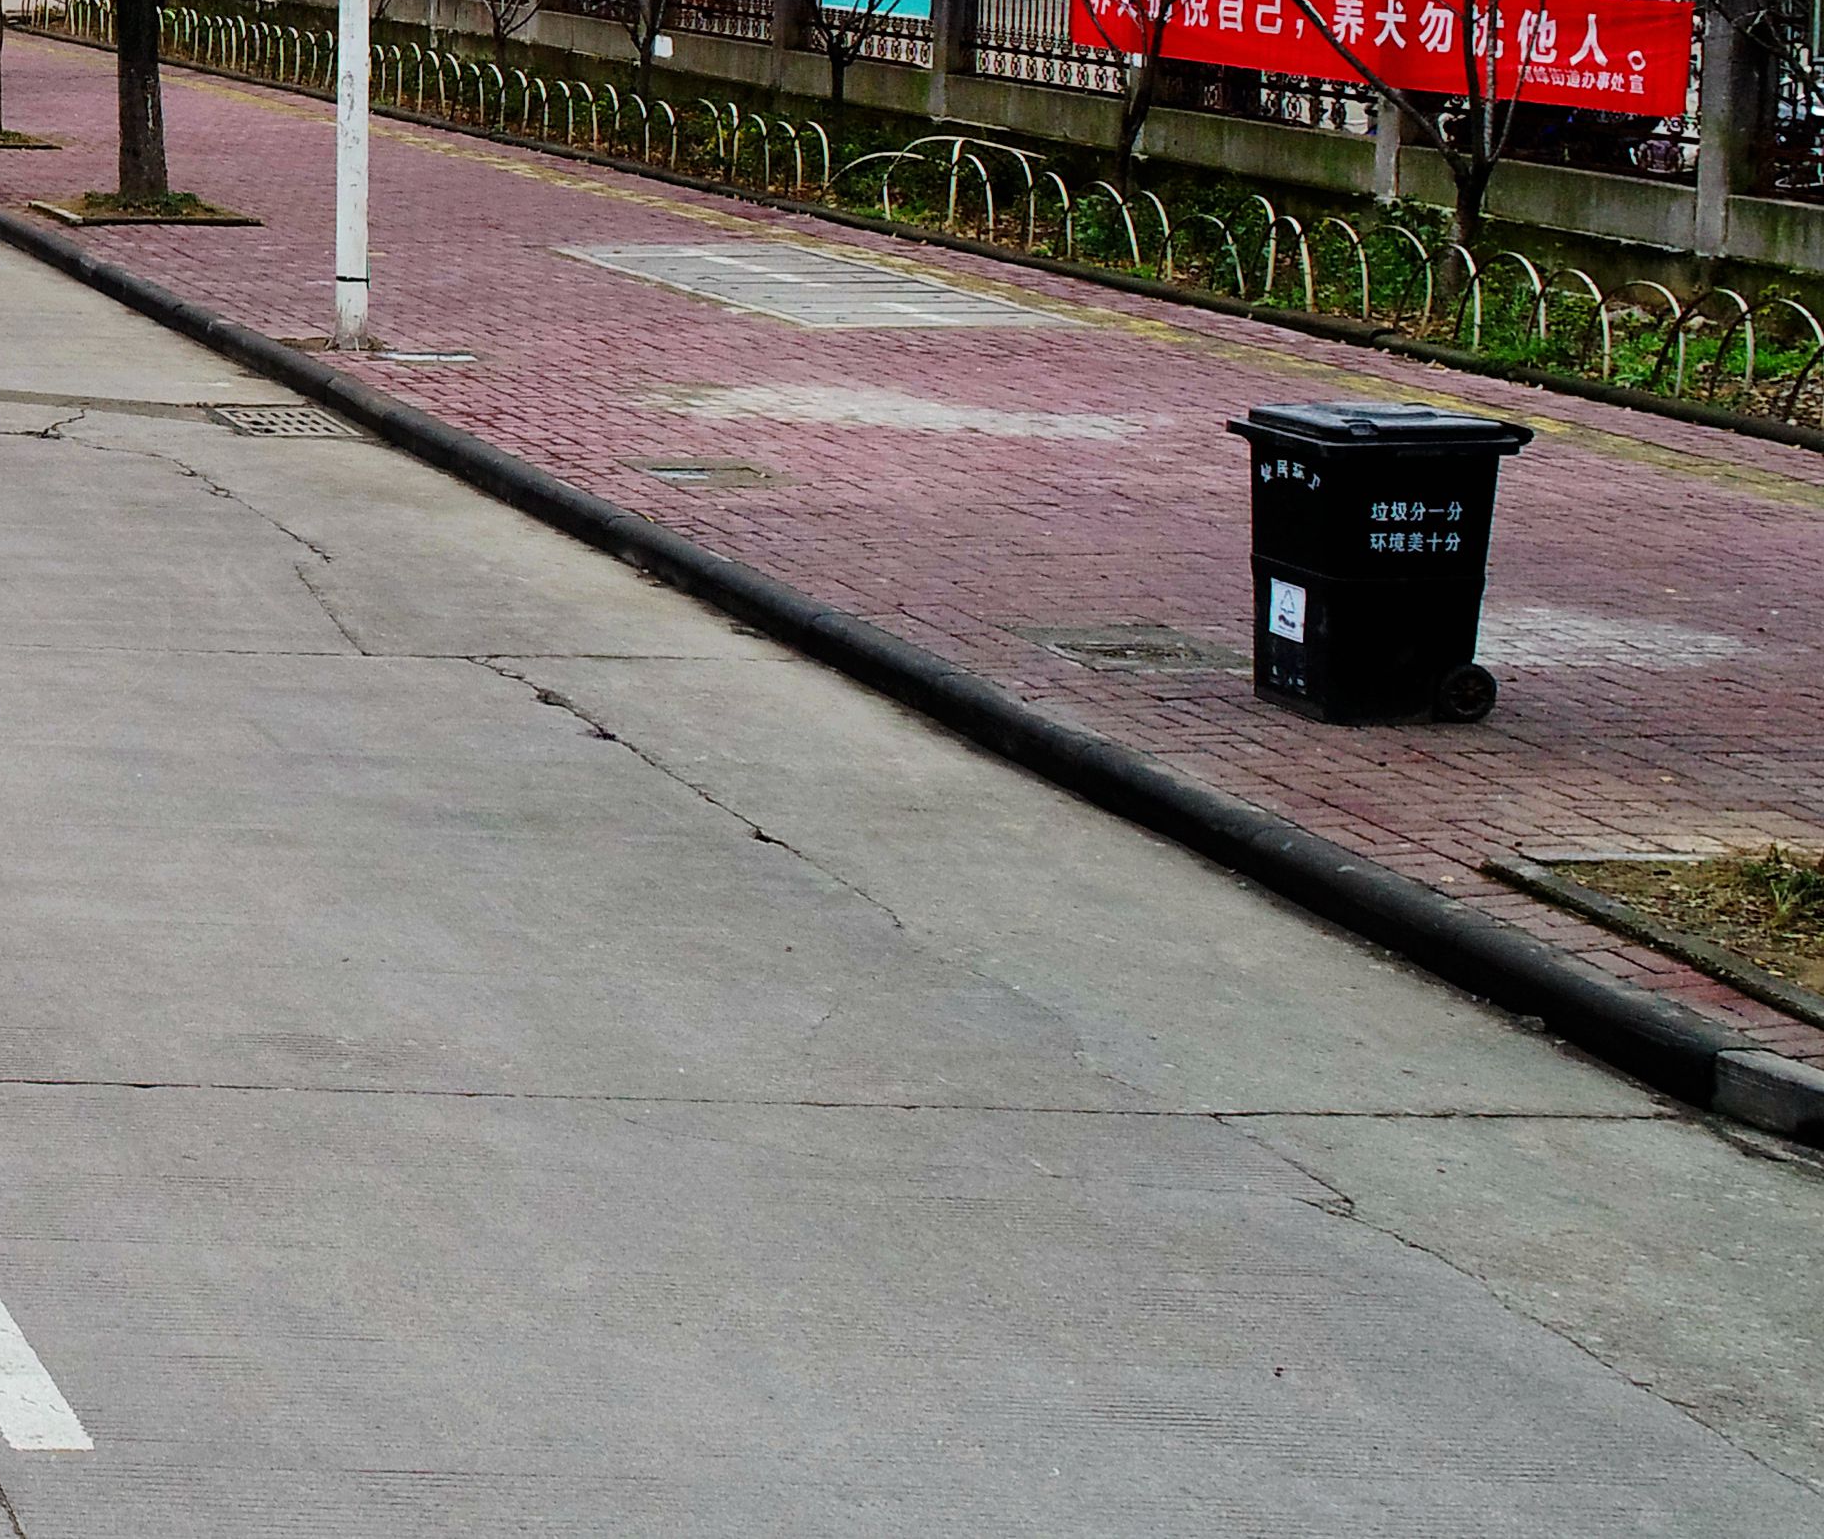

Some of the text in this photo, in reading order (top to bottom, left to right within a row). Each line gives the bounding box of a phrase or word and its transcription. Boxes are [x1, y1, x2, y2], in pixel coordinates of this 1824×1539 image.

[1629, 74, 1645, 94] 宣
[1370, 501, 1464, 522] 垃圾分一分
[1369, 531, 1461, 553] 环境美十分
